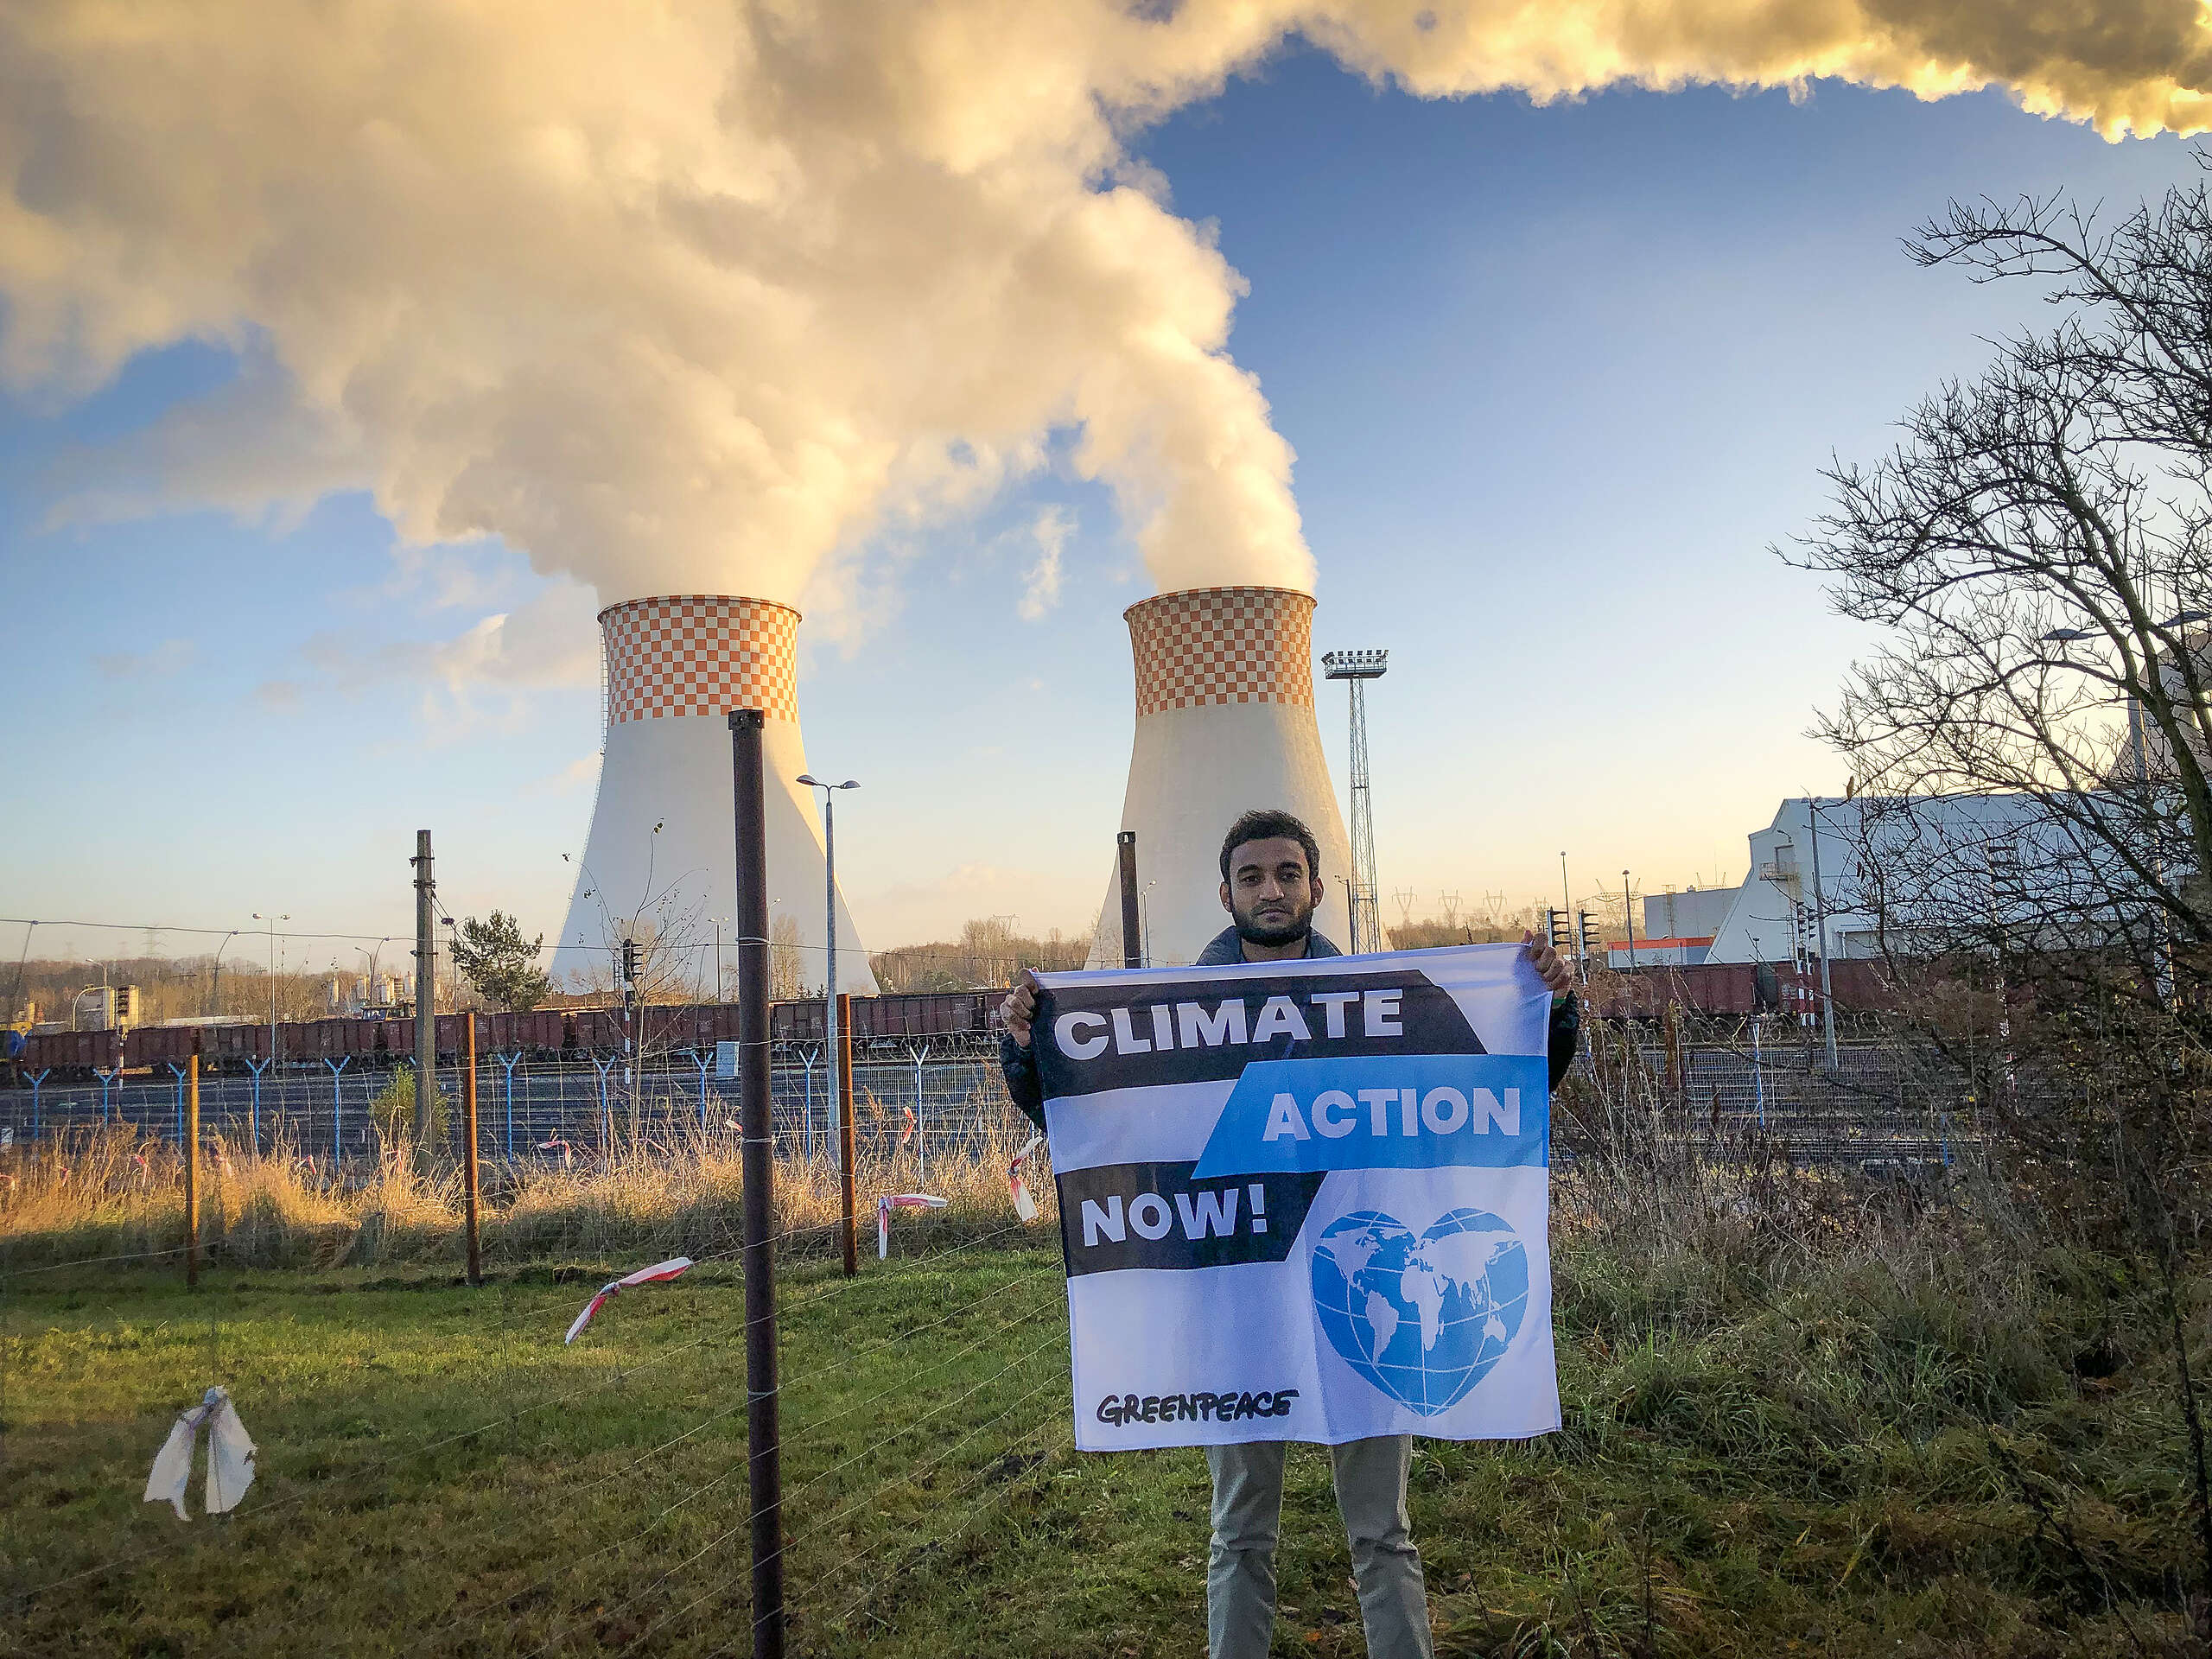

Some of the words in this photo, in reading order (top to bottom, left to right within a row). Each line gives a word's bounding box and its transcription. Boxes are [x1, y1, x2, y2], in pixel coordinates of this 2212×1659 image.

[1054, 989, 1403, 1060] CLIMATE
[1262, 1087, 1521, 1141] ACTION
[1081, 1185, 1268, 1247] NOW!
[1096, 1389, 1300, 1427] GREENPEACE
